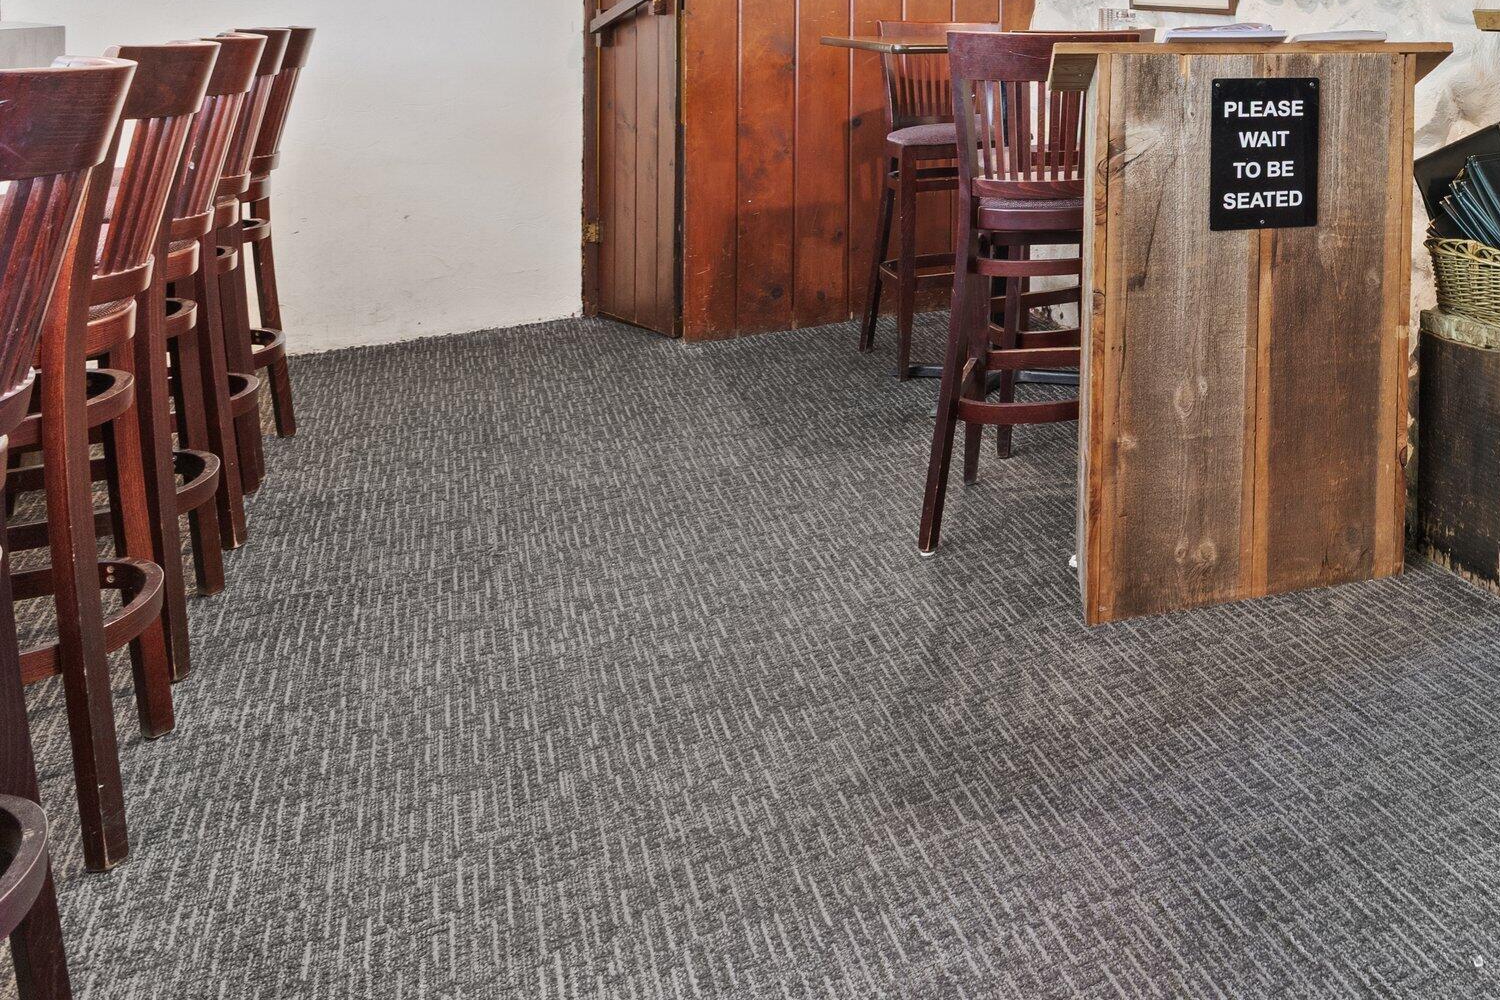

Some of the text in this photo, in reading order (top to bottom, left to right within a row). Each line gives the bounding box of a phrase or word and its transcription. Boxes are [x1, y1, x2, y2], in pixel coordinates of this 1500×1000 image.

[1223, 100, 1304, 118] PLEASE
[1238, 131, 1290, 148] WAIT
[1233, 160, 1294, 179] TO BE
[1222, 190, 1303, 210] SEATED
